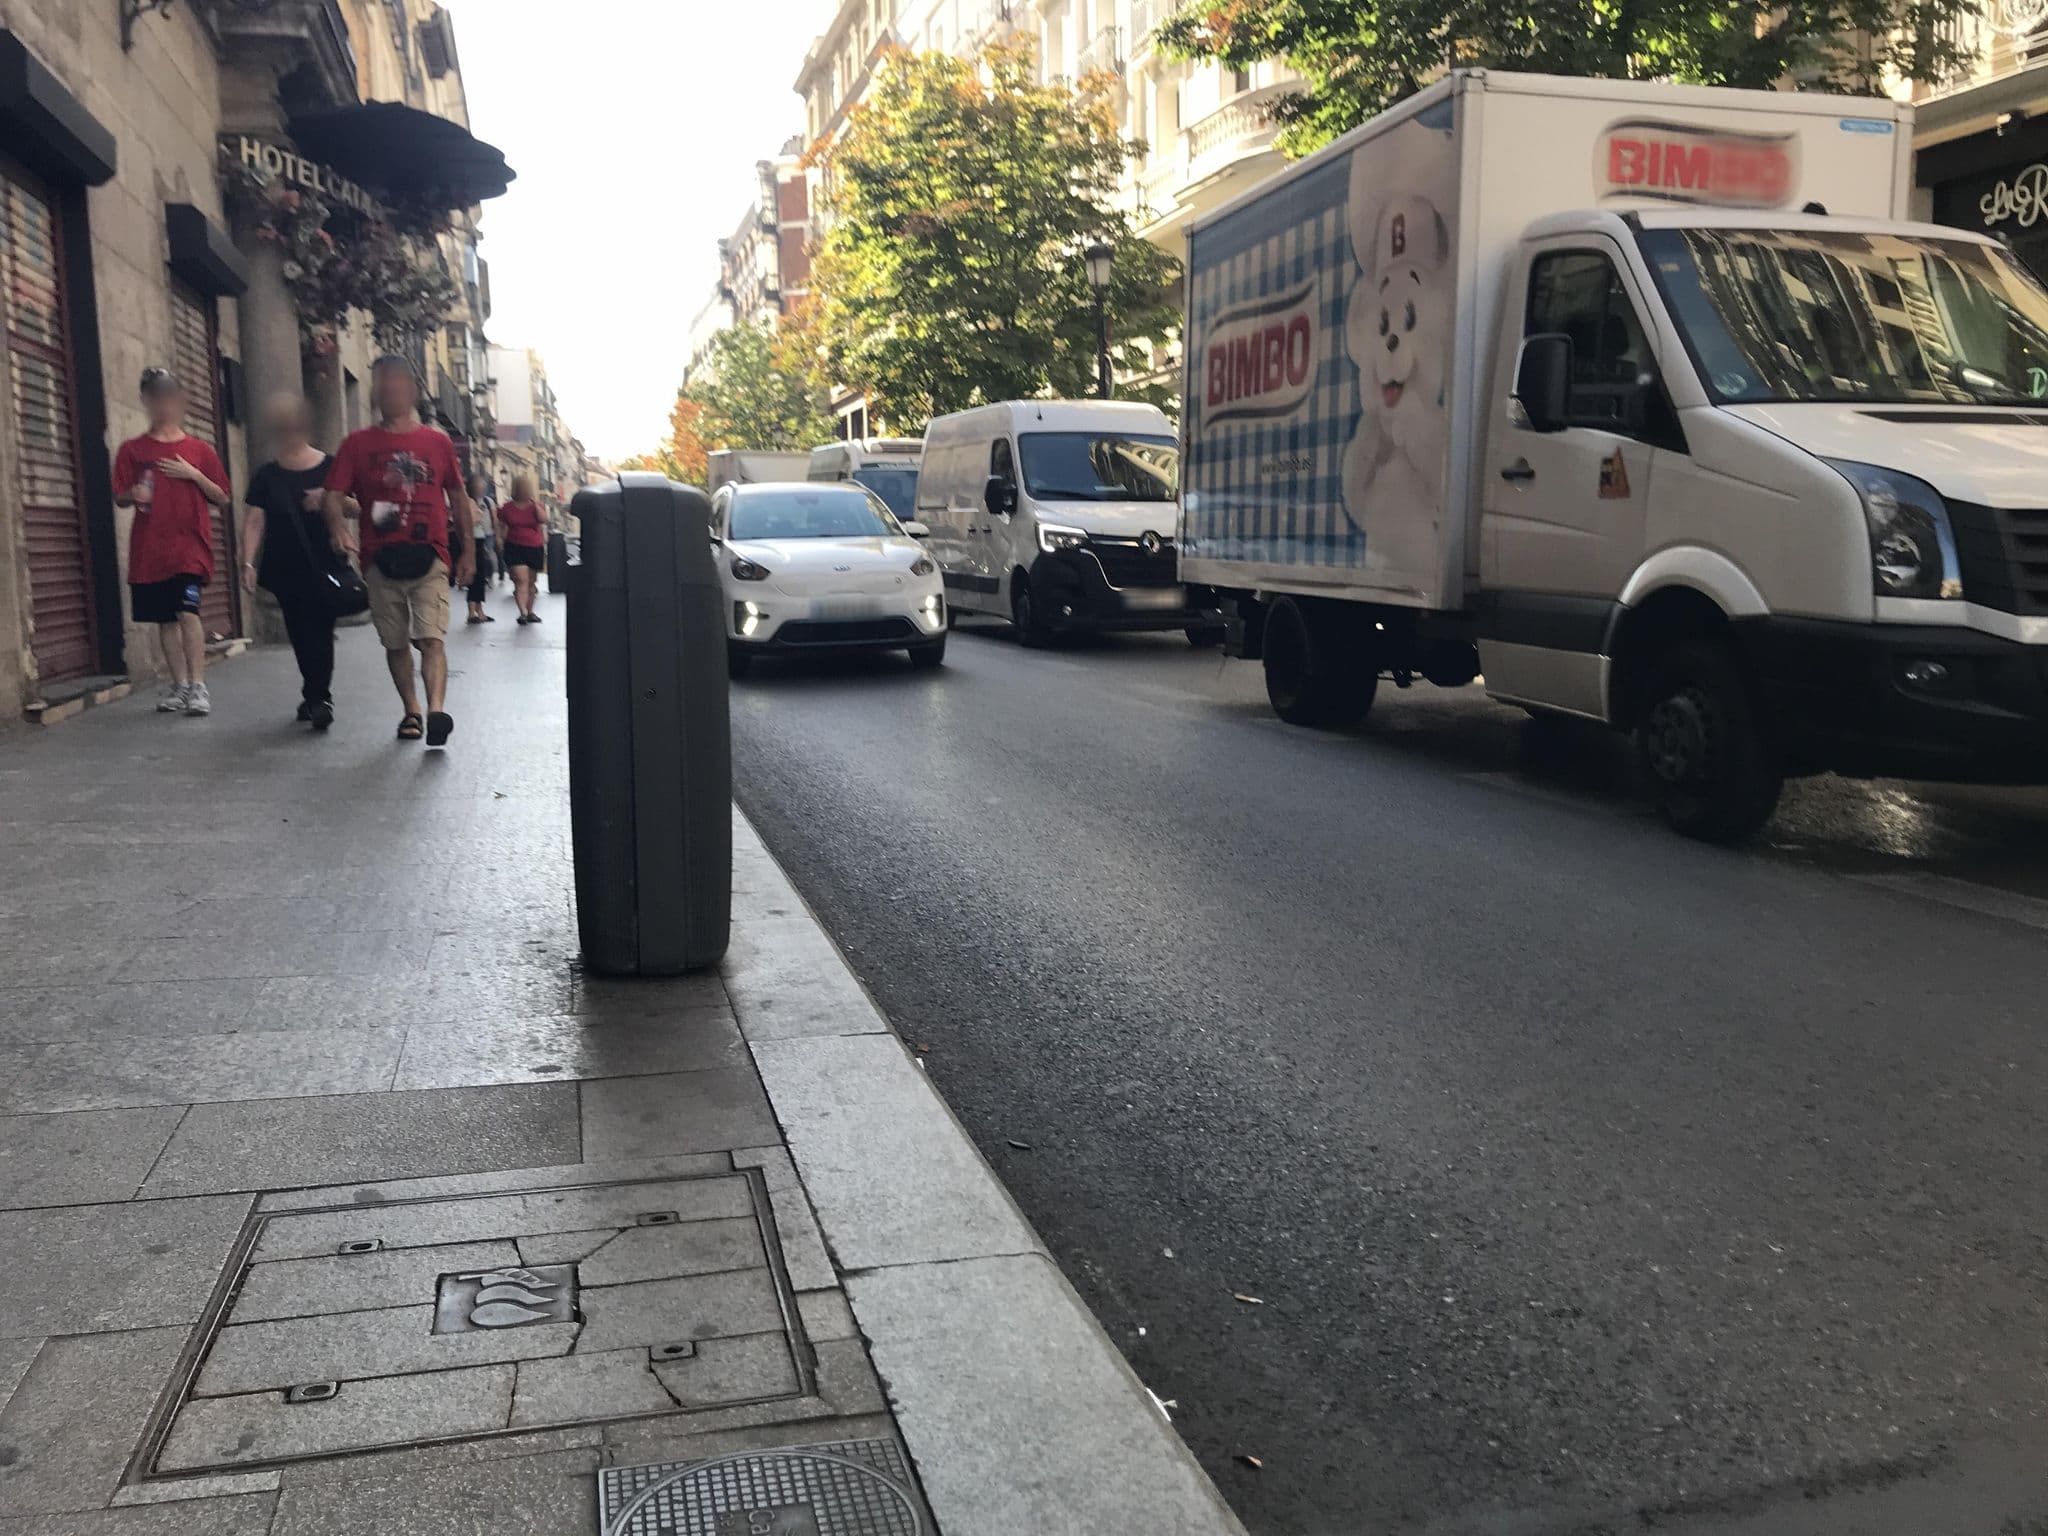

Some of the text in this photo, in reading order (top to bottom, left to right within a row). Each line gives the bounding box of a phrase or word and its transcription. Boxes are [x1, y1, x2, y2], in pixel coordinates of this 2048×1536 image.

[240, 136, 327, 193] HOTEL
[1608, 137, 1791, 201] BIM
[1392, 213, 1406, 258] B
[1207, 311, 1311, 408] BIMBO
